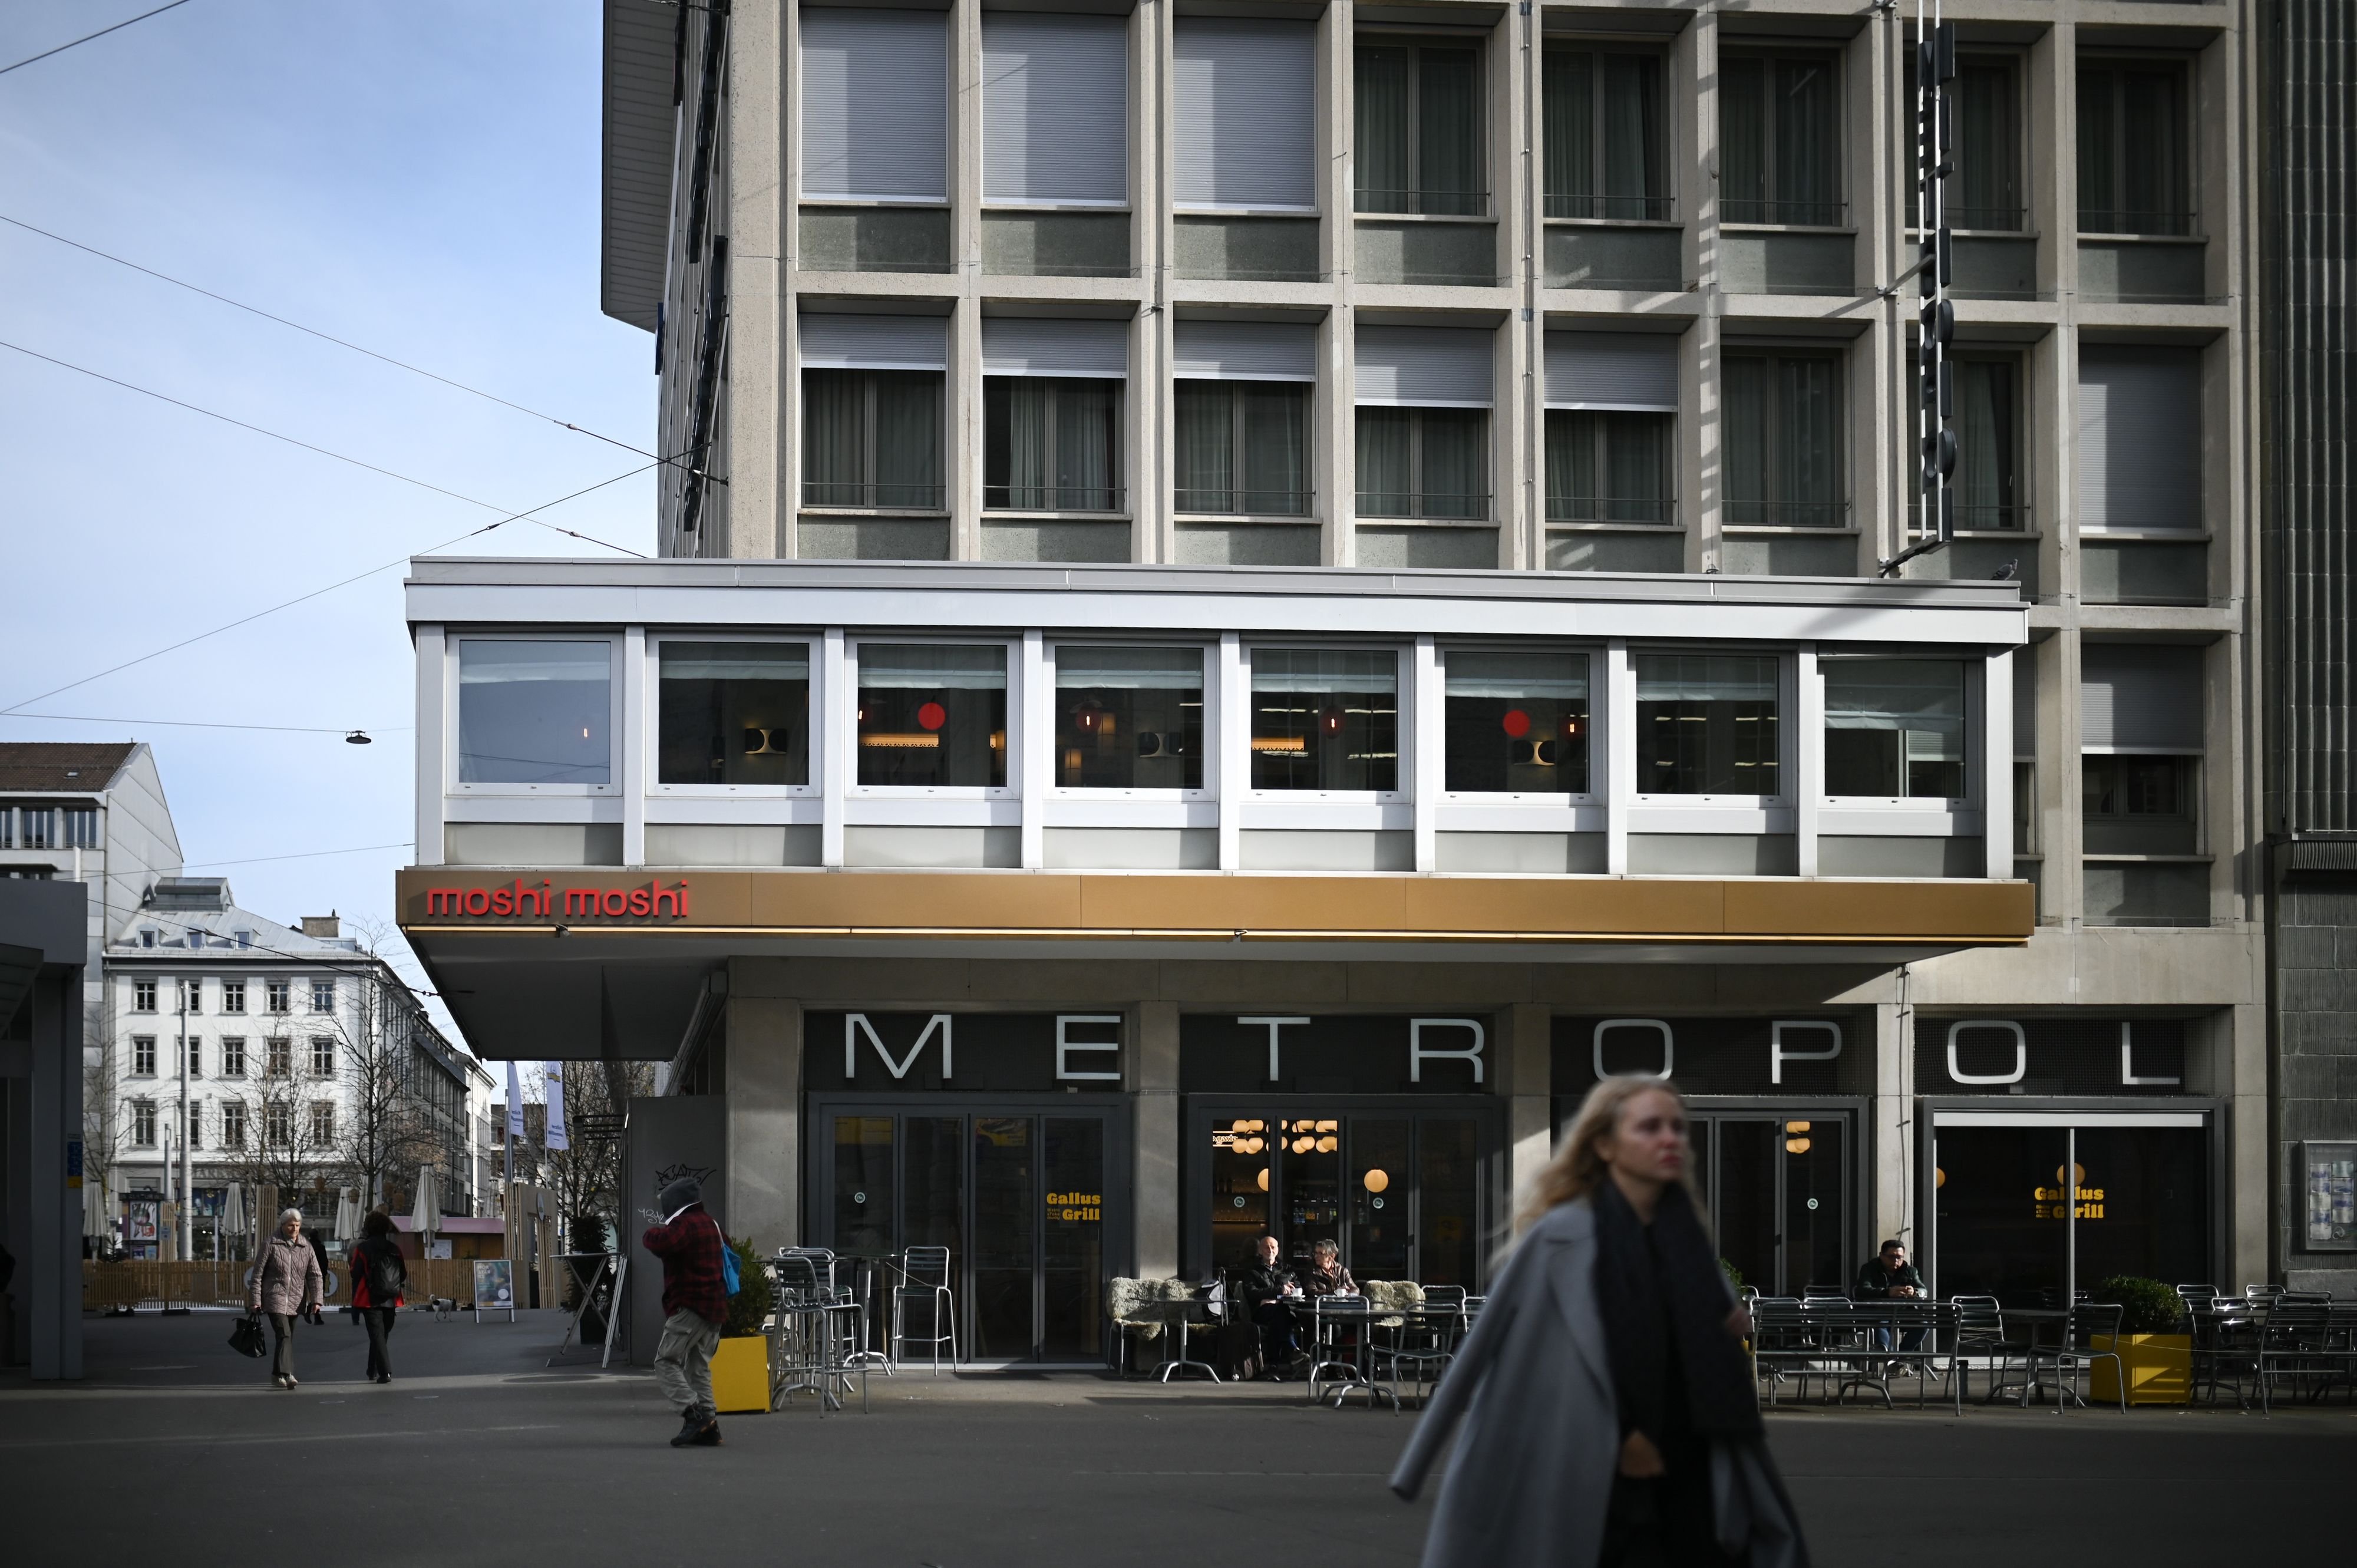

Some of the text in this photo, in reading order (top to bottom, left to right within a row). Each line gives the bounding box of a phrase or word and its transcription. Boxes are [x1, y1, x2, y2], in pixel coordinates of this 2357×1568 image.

[427, 879, 688, 916] moshi moshi
[846, 1014, 2180, 1085] METROPOL
[1047, 1192, 1101, 1204] Gallus
[2034, 1186, 2104, 1200] Gallus
[1062, 1207, 1100, 1220] Grill
[2052, 1203, 2104, 1219] Grill
